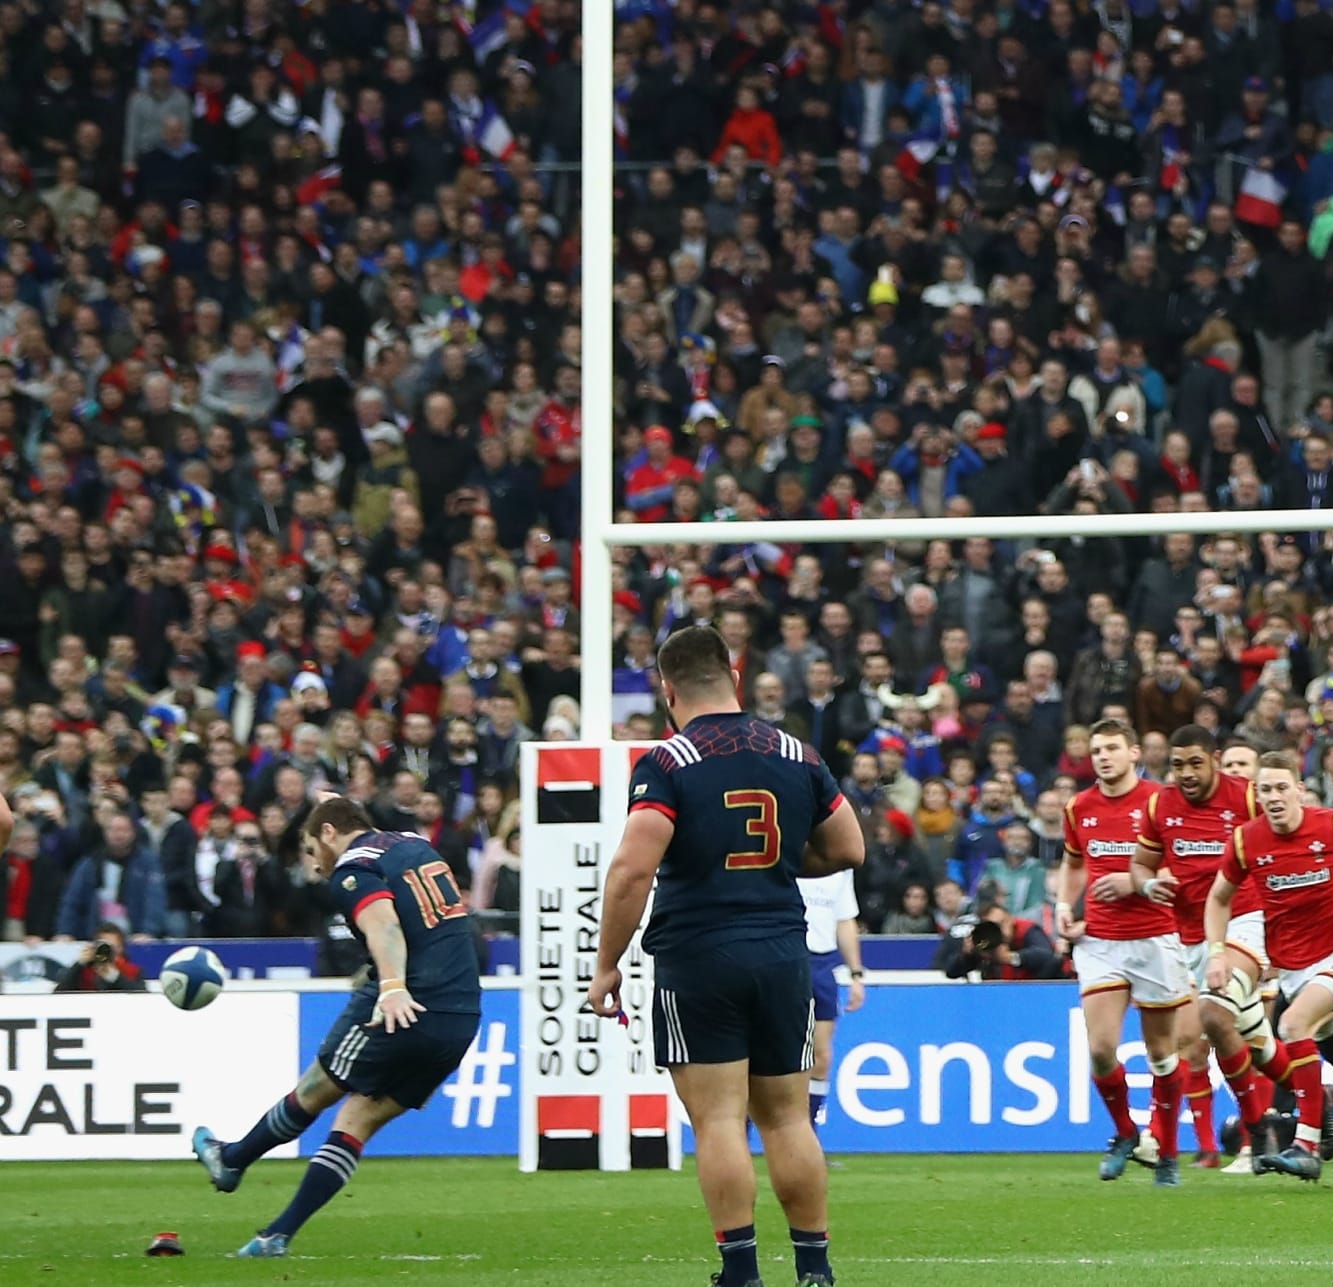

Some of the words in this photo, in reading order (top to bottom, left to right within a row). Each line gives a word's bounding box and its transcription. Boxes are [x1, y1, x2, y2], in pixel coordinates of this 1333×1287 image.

[402, 860, 468, 929] 10
[724, 788, 782, 870] 3
[538, 887, 563, 1076] SOCIETE
[575, 842, 601, 1077] GENERALE
